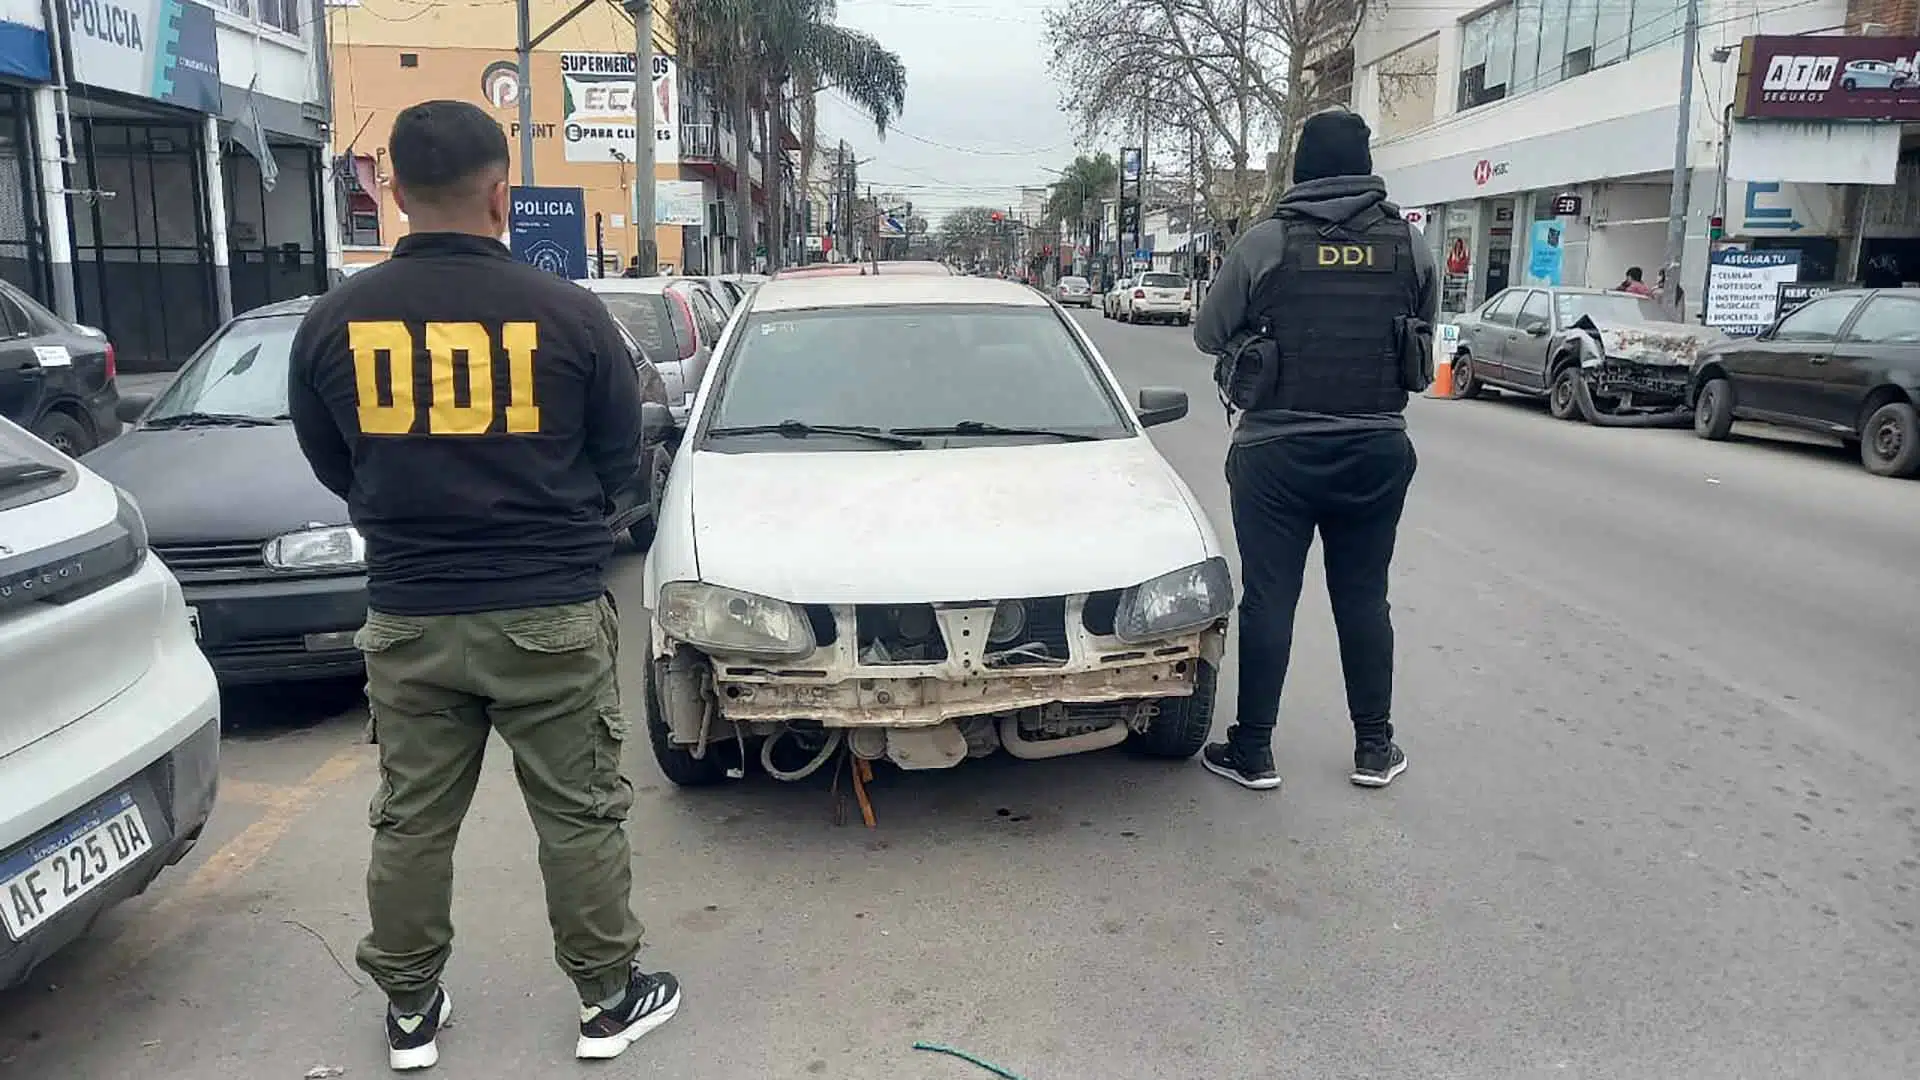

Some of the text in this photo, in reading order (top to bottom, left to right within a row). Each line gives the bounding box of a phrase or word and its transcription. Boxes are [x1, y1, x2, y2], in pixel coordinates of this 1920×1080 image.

[561, 55, 668, 74] SUPERMERCOS
[1771, 63, 1833, 82] ATM
[511, 123, 556, 138] PINT
[583, 128, 613, 138] PARA
[617, 128, 671, 140] CLIES
[514, 201, 575, 216] POLICIA
[1318, 245, 1373, 266] DDI
[1723, 255, 1786, 265] ASEGURA TU
[347, 321, 541, 435] DDI
[8, 814, 147, 927] AF 225 DA
